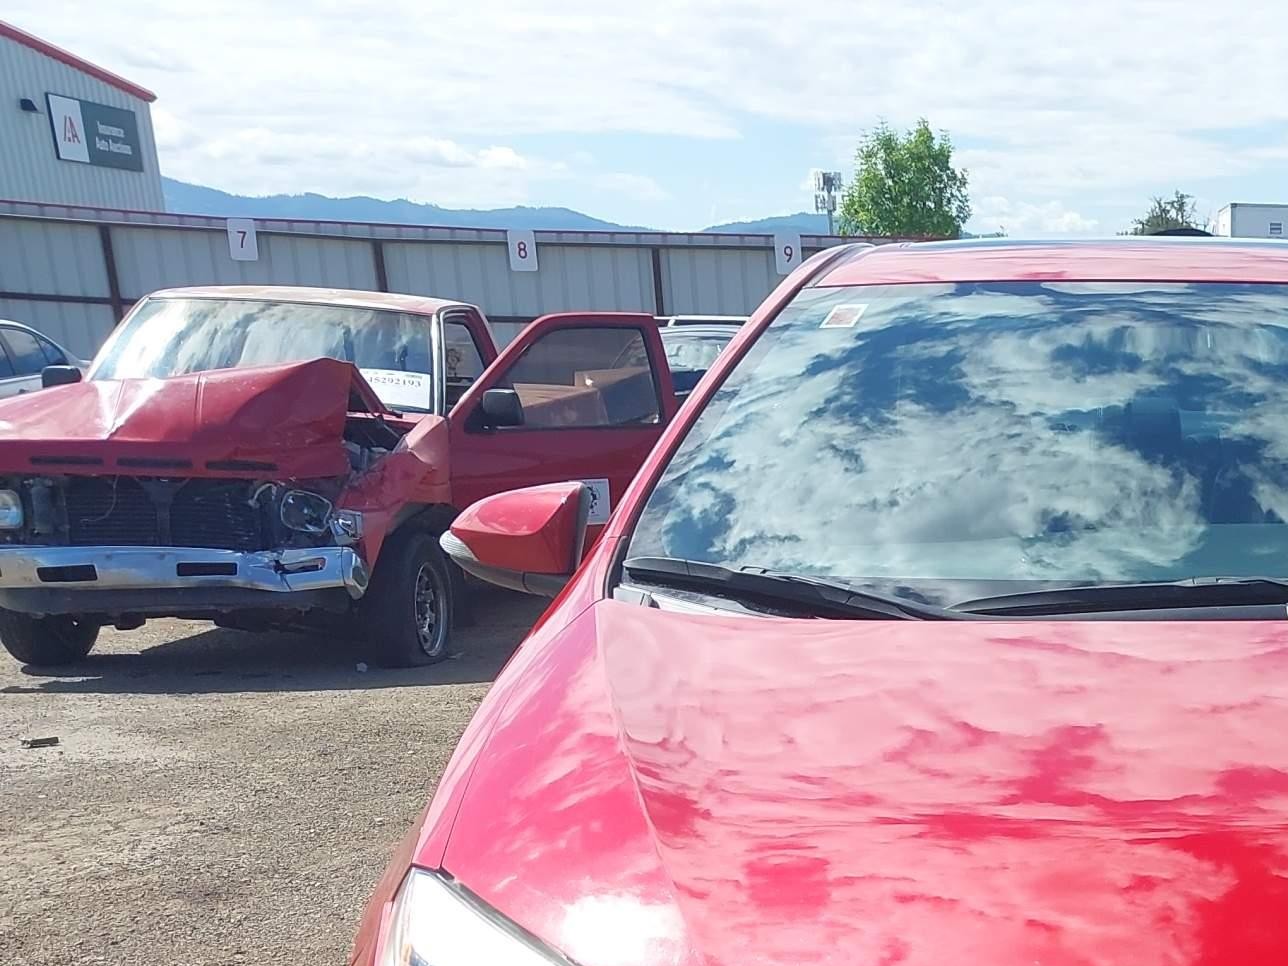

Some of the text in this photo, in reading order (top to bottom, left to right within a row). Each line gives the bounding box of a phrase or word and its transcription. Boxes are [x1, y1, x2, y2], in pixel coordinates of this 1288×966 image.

[236, 230, 247, 249] 7
[517, 240, 528, 259] 8
[783, 245, 793, 263] 9
